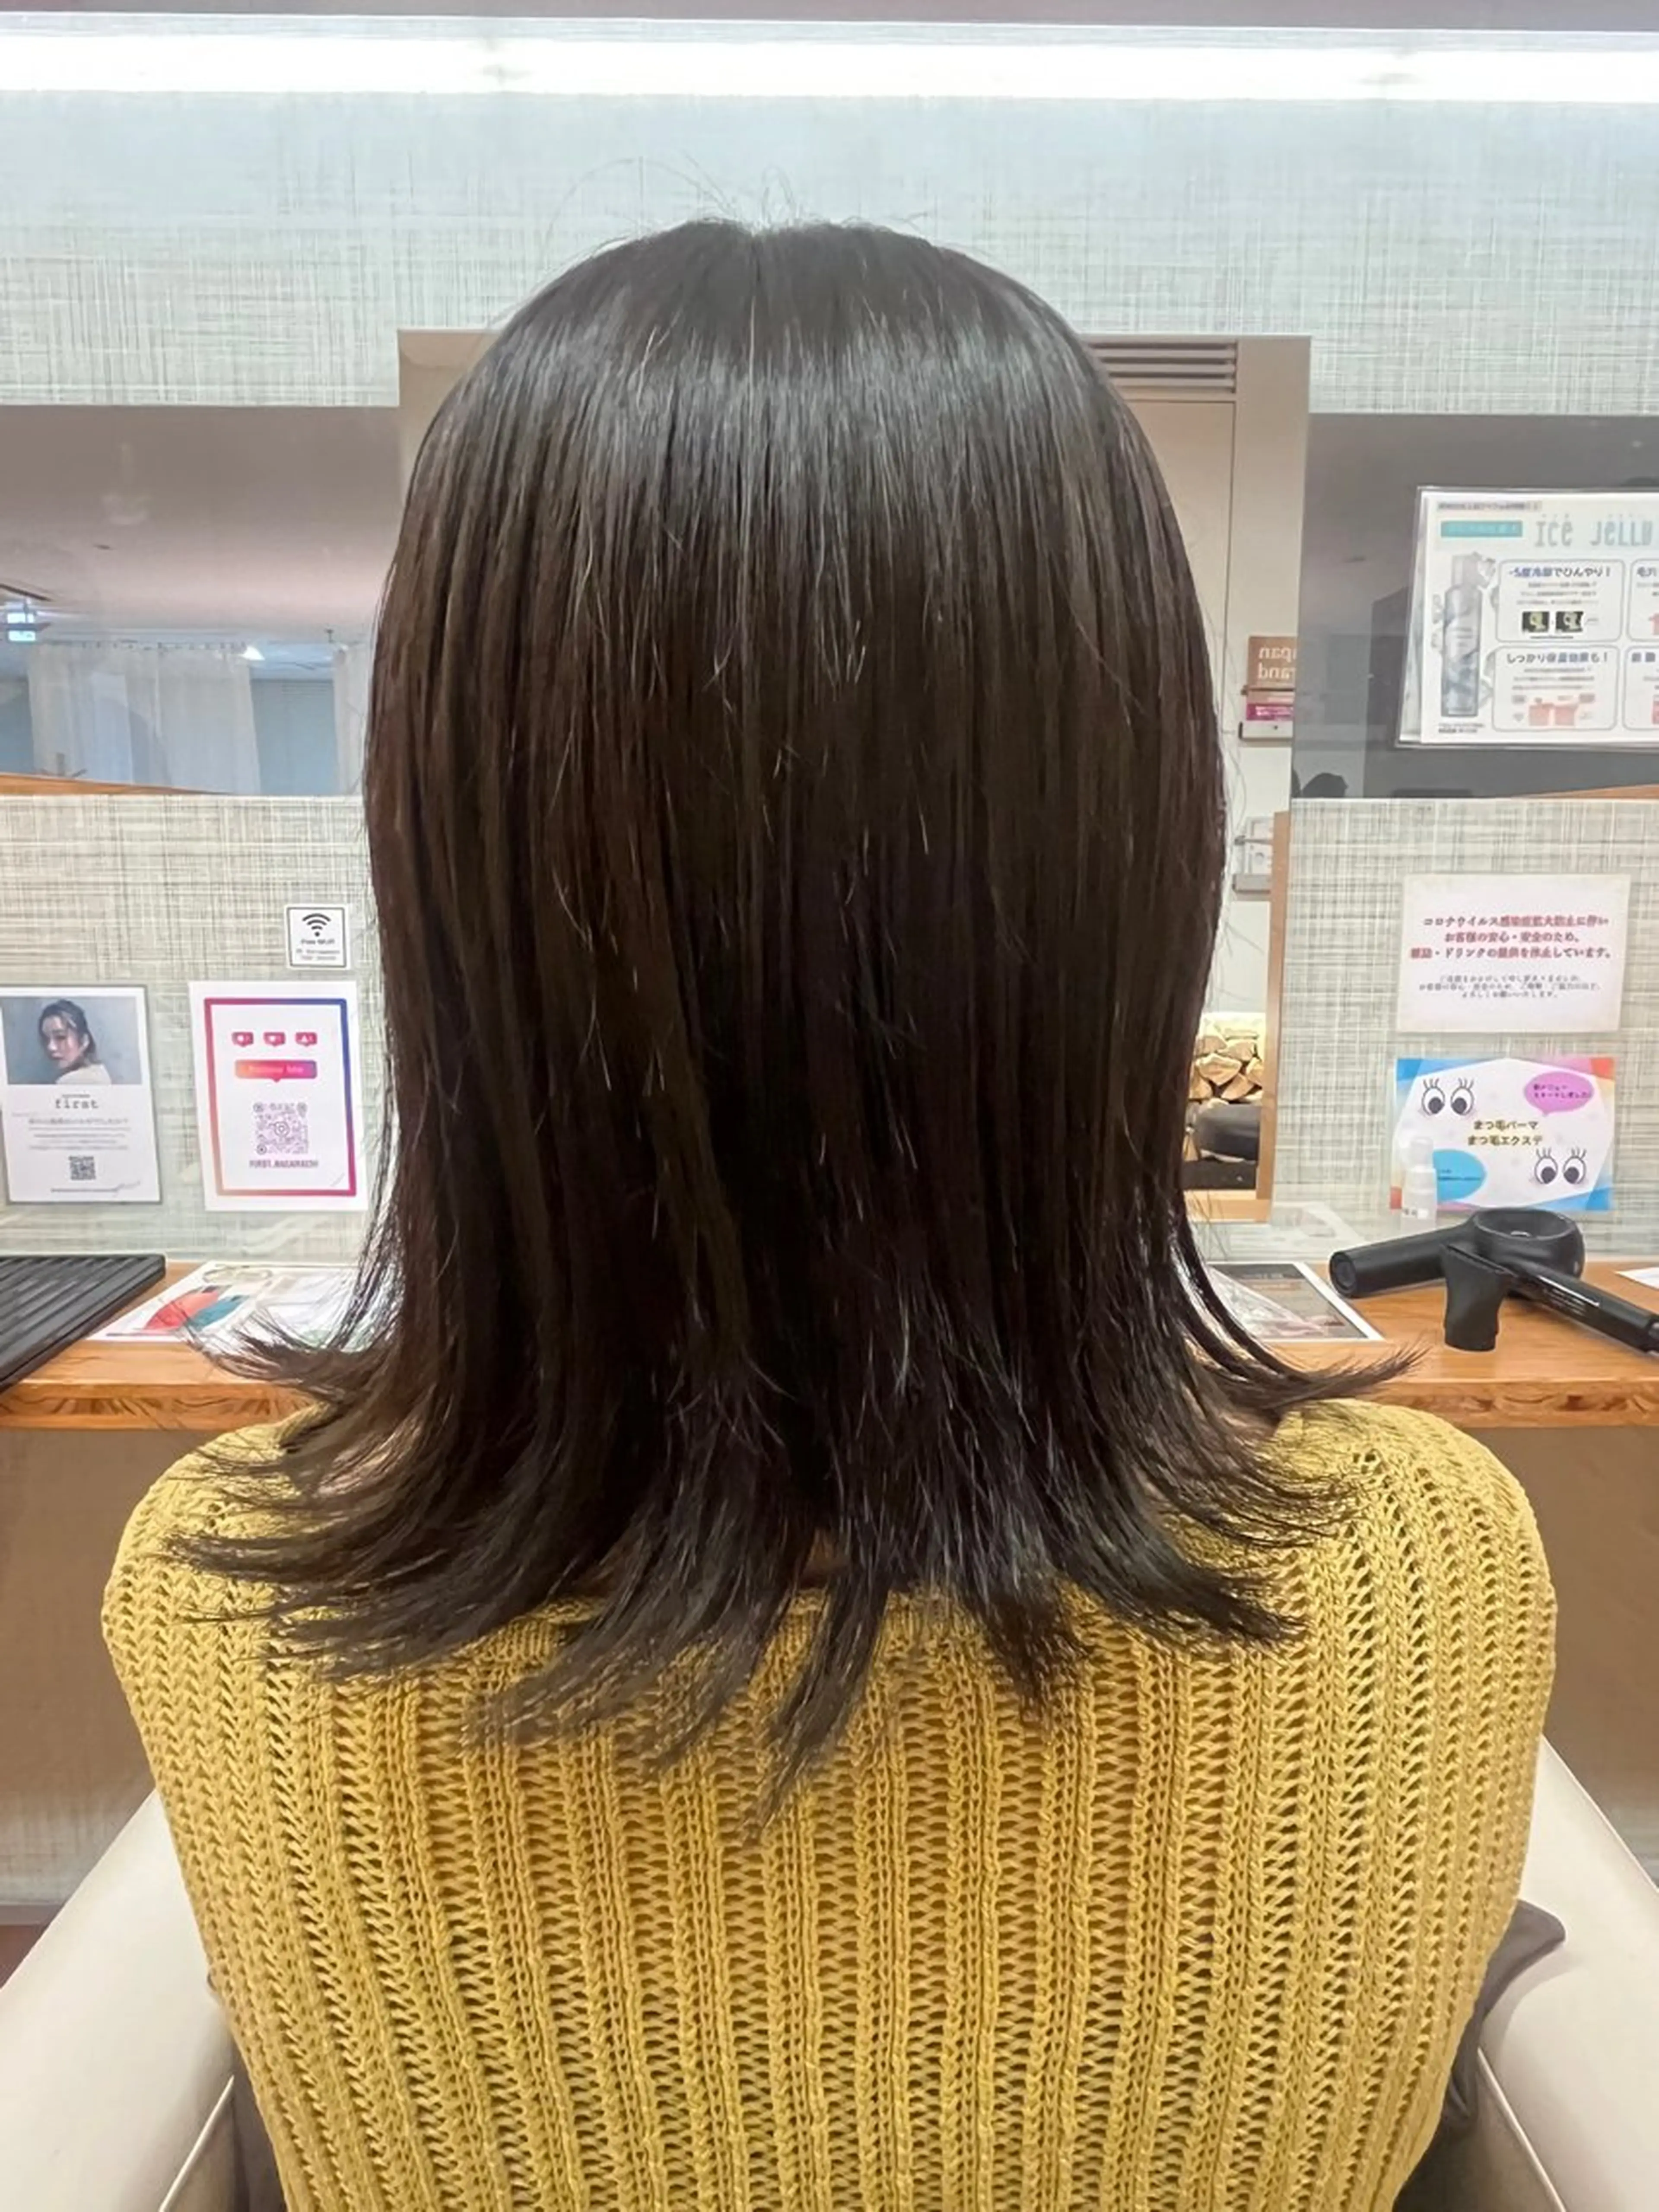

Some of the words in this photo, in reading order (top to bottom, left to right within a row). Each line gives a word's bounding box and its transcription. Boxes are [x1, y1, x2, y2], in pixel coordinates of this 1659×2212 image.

[1474, 1120, 1538, 1131] まつ毛パーマ
[1468, 1135, 1543, 1147] まつ毛エクステ
